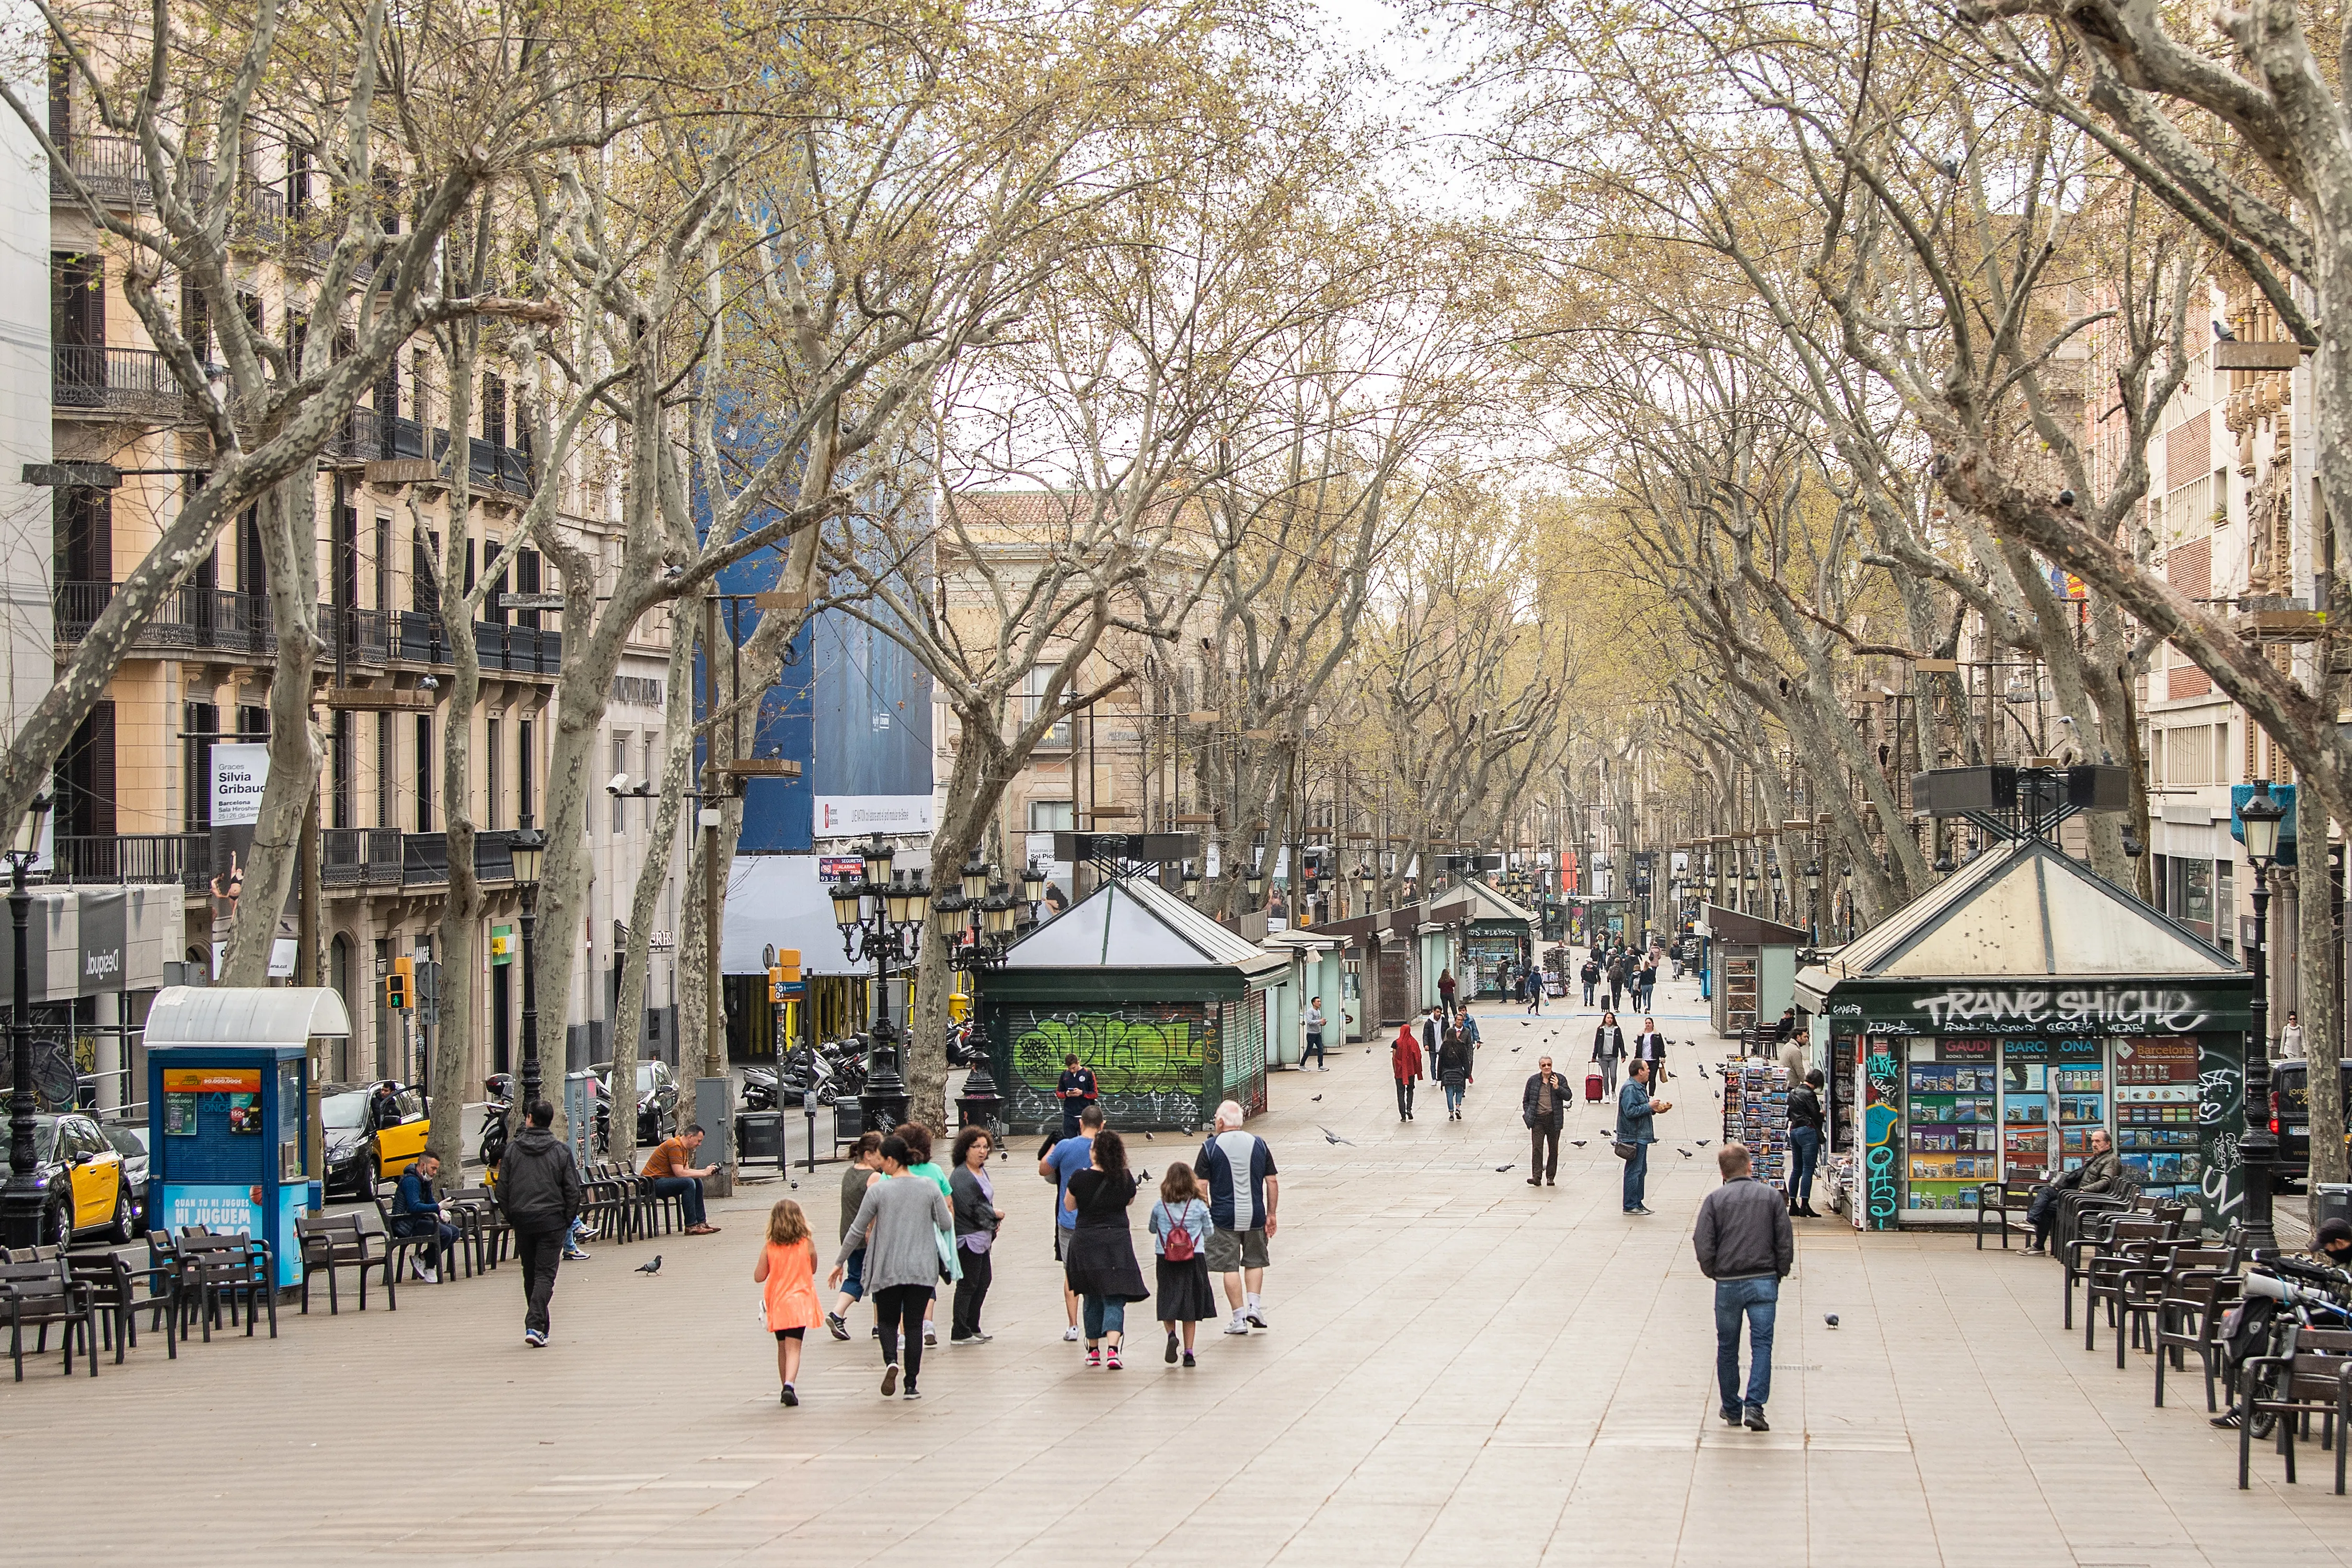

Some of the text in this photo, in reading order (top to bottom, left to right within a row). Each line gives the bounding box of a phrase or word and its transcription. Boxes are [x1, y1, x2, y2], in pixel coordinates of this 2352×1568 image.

[219, 772, 251, 782] Silvia
[415, 946, 430, 963] ANGE
[1945, 1040, 1991, 1052] GAUDI
[2005, 1040, 2094, 1052] BARCONA
[2137, 1045, 2194, 1054] Barcelona
[176, 1208, 251, 1224] HI JUGUEM
